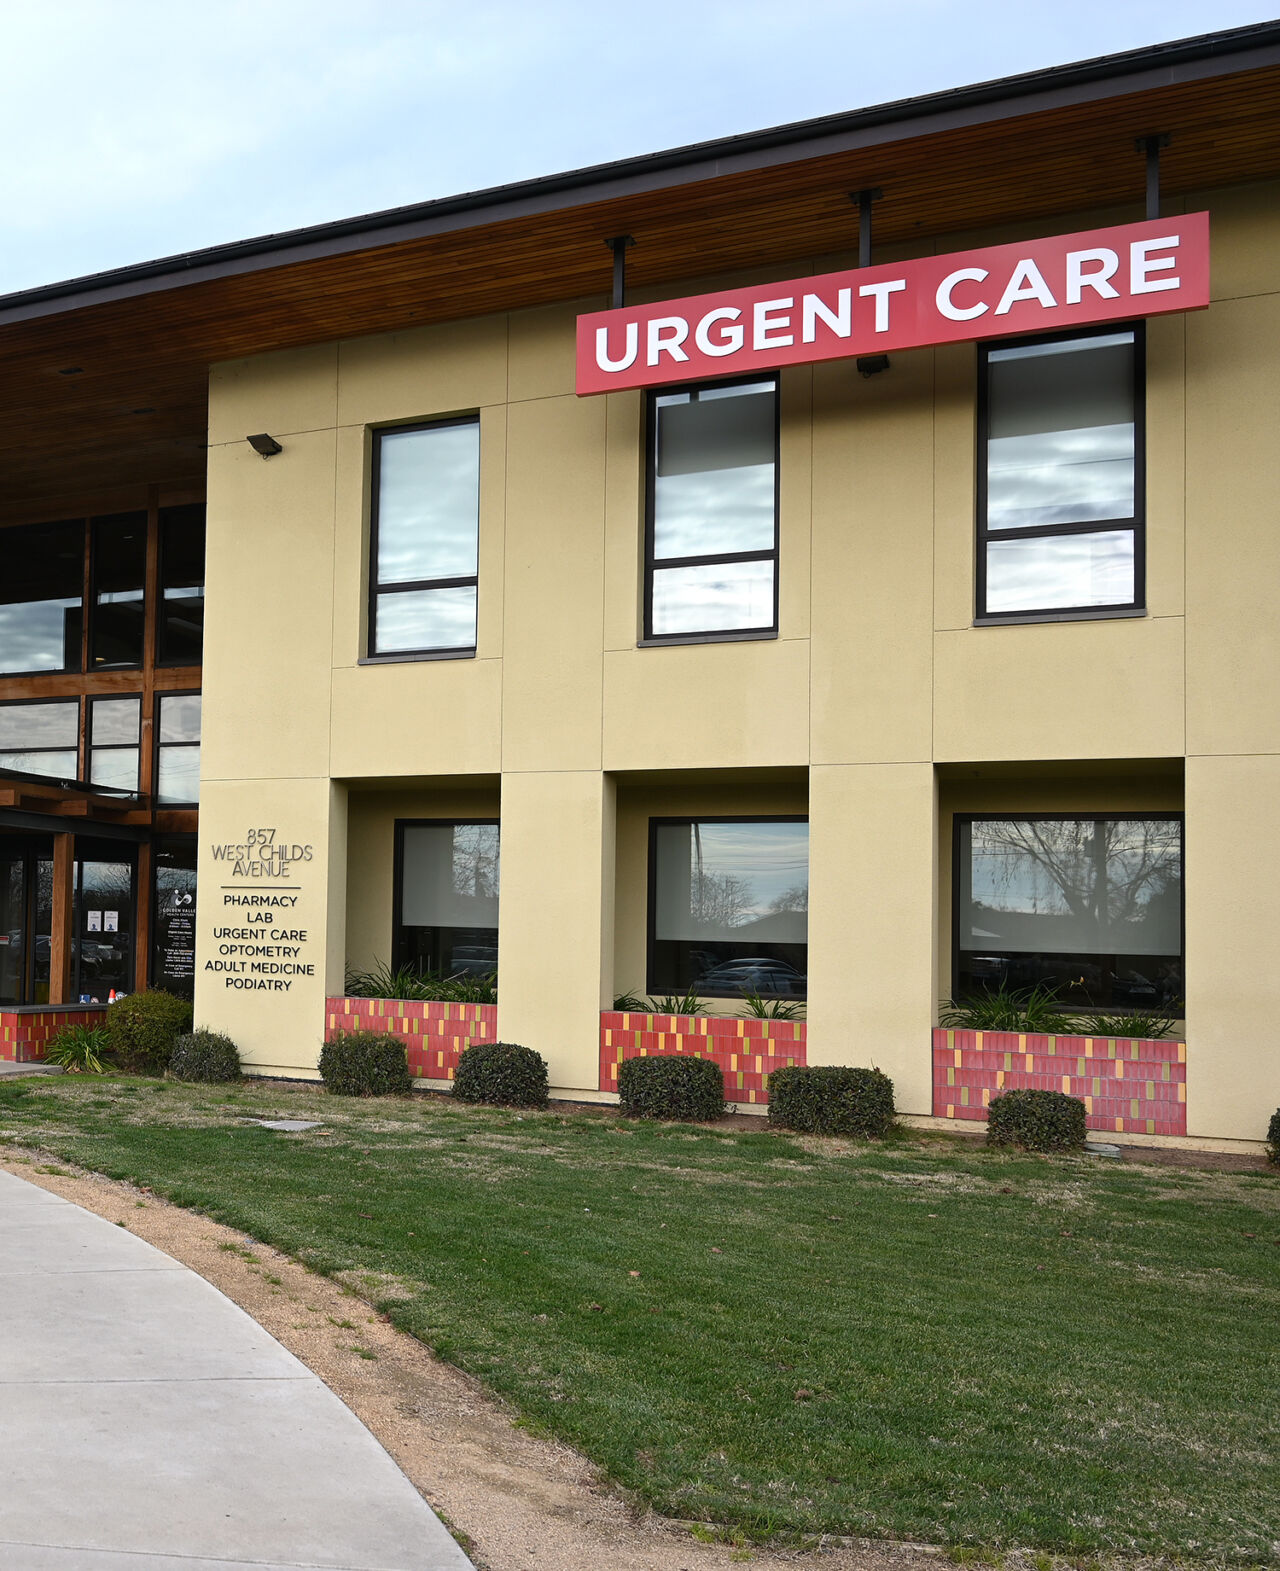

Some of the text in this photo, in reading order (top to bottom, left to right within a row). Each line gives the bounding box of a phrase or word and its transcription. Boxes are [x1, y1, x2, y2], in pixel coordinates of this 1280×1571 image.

[595, 235, 1181, 373] URGENT CARE
[247, 828, 277, 845] 857
[211, 844, 313, 862] WEST CHILDS
[232, 860, 290, 878] AVENUE
[223, 895, 298, 907] PHARMACY
[247, 912, 273, 923] LAB
[213, 927, 308, 942] URGENT CARE
[219, 944, 300, 957] OPTOMETRY
[205, 960, 315, 976] ADULT MEDICINE
[225, 977, 292, 991] PODIATRY
